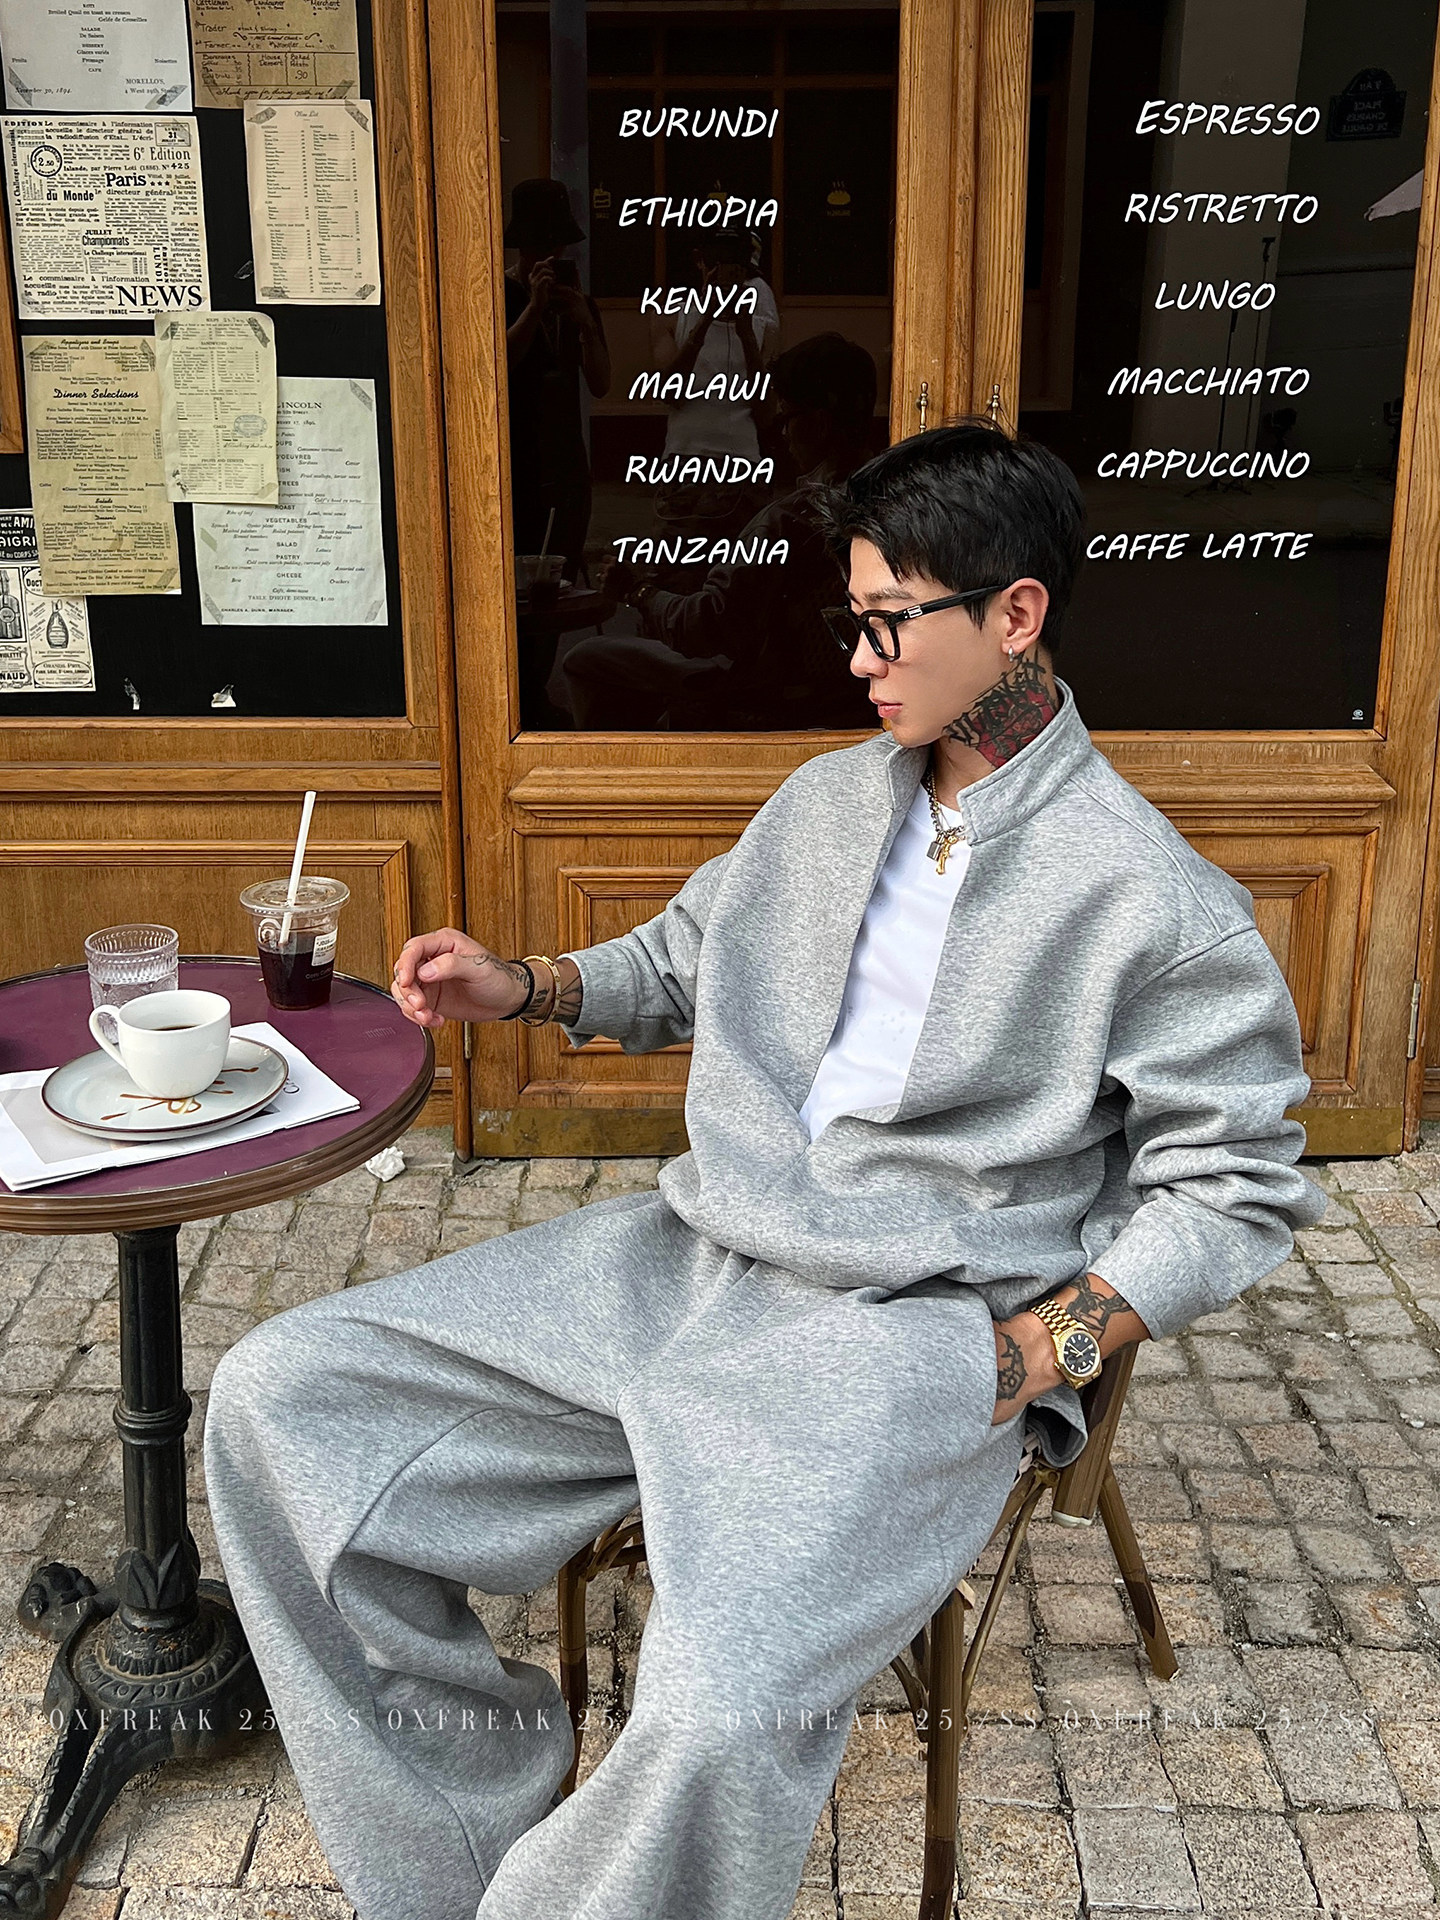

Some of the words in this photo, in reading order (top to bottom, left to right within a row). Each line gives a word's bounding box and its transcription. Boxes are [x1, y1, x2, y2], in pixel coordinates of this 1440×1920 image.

[620, 107, 778, 138] BURUNDI
[1136, 101, 1320, 135] ESPRESSO
[150, 147, 191, 160] Edition
[105, 173, 147, 187] Paris
[47, 190, 57, 200] du
[64, 190, 94, 200] Monde
[1125, 193, 1319, 224] RISTRETTO
[619, 196, 778, 228] ETHIOPIA
[82, 236, 130, 247] Championnats
[153, 247, 162, 282] LUNDI
[116, 285, 202, 306] NEWS
[641, 284, 758, 318] KENYA
[1155, 280, 1276, 310] LUNGO
[53, 388, 87, 398] Dinner
[91, 388, 139, 398] Selections
[629, 371, 771, 401] MALAWI
[1107, 367, 1310, 396] MACCHIATO
[625, 455, 774, 484] RWANDA
[1097, 449, 1310, 479] CAPPUCCINO
[613, 536, 789, 564] TANZANIA
[1086, 533, 1190, 560] CAFFE
[1202, 532, 1314, 560] LATTE
